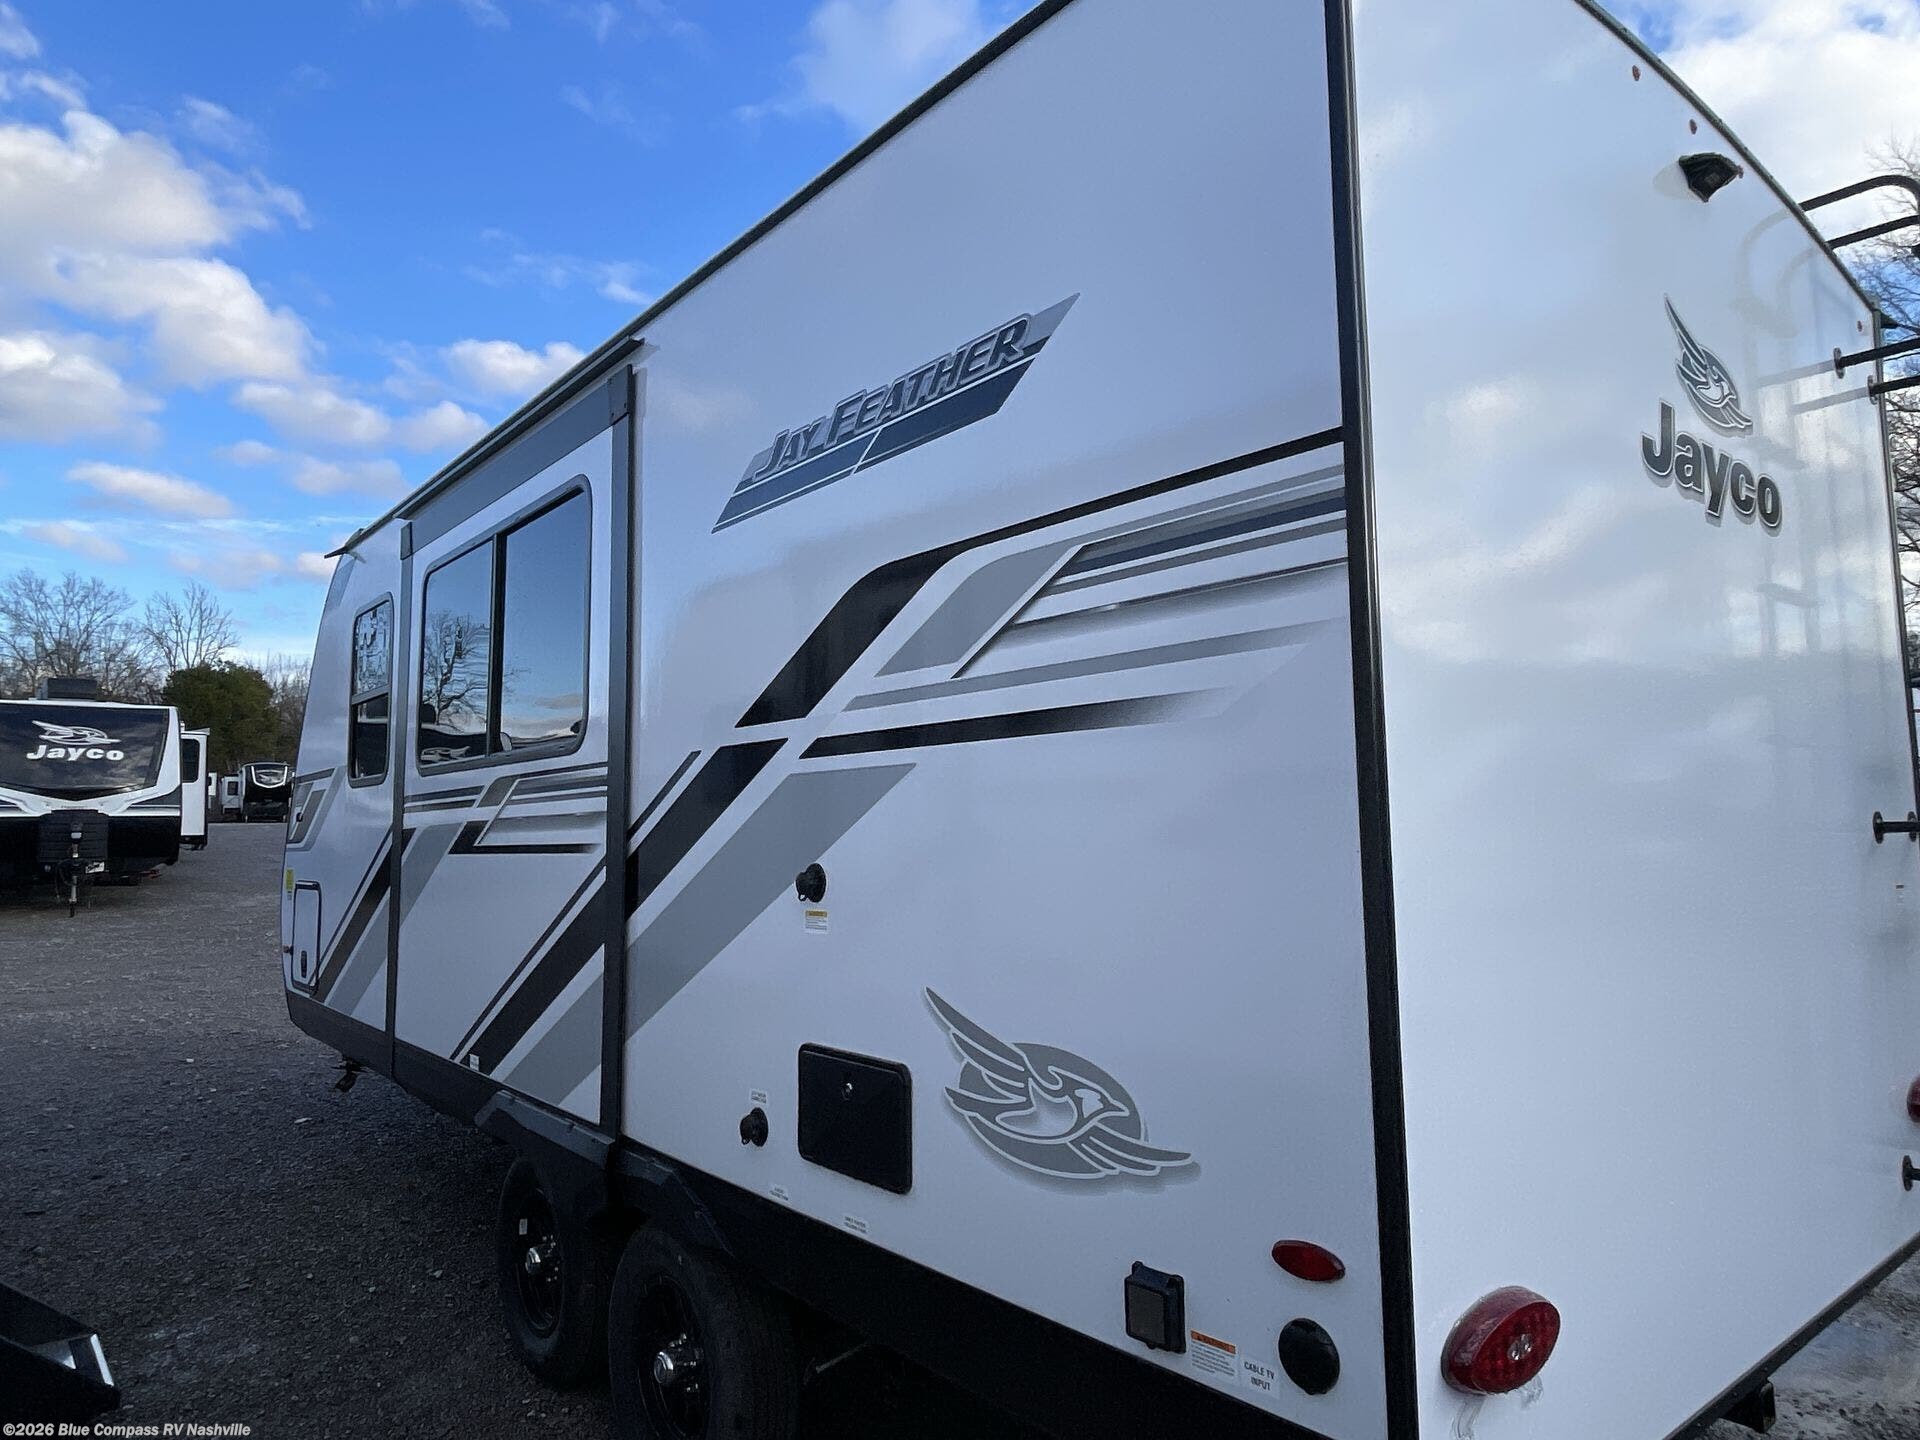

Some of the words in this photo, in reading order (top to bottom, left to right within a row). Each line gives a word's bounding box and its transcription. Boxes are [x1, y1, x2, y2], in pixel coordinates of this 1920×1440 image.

[752, 419, 828, 480] JAY
[824, 314, 1030, 446] FEATHER
[1641, 400, 1781, 527] Jayco
[26, 745, 125, 761] Jayco
[1244, 1361, 1265, 1377] CABLE
[1266, 1369, 1275, 1380] TV
[1251, 1376, 1271, 1391] INPUT
